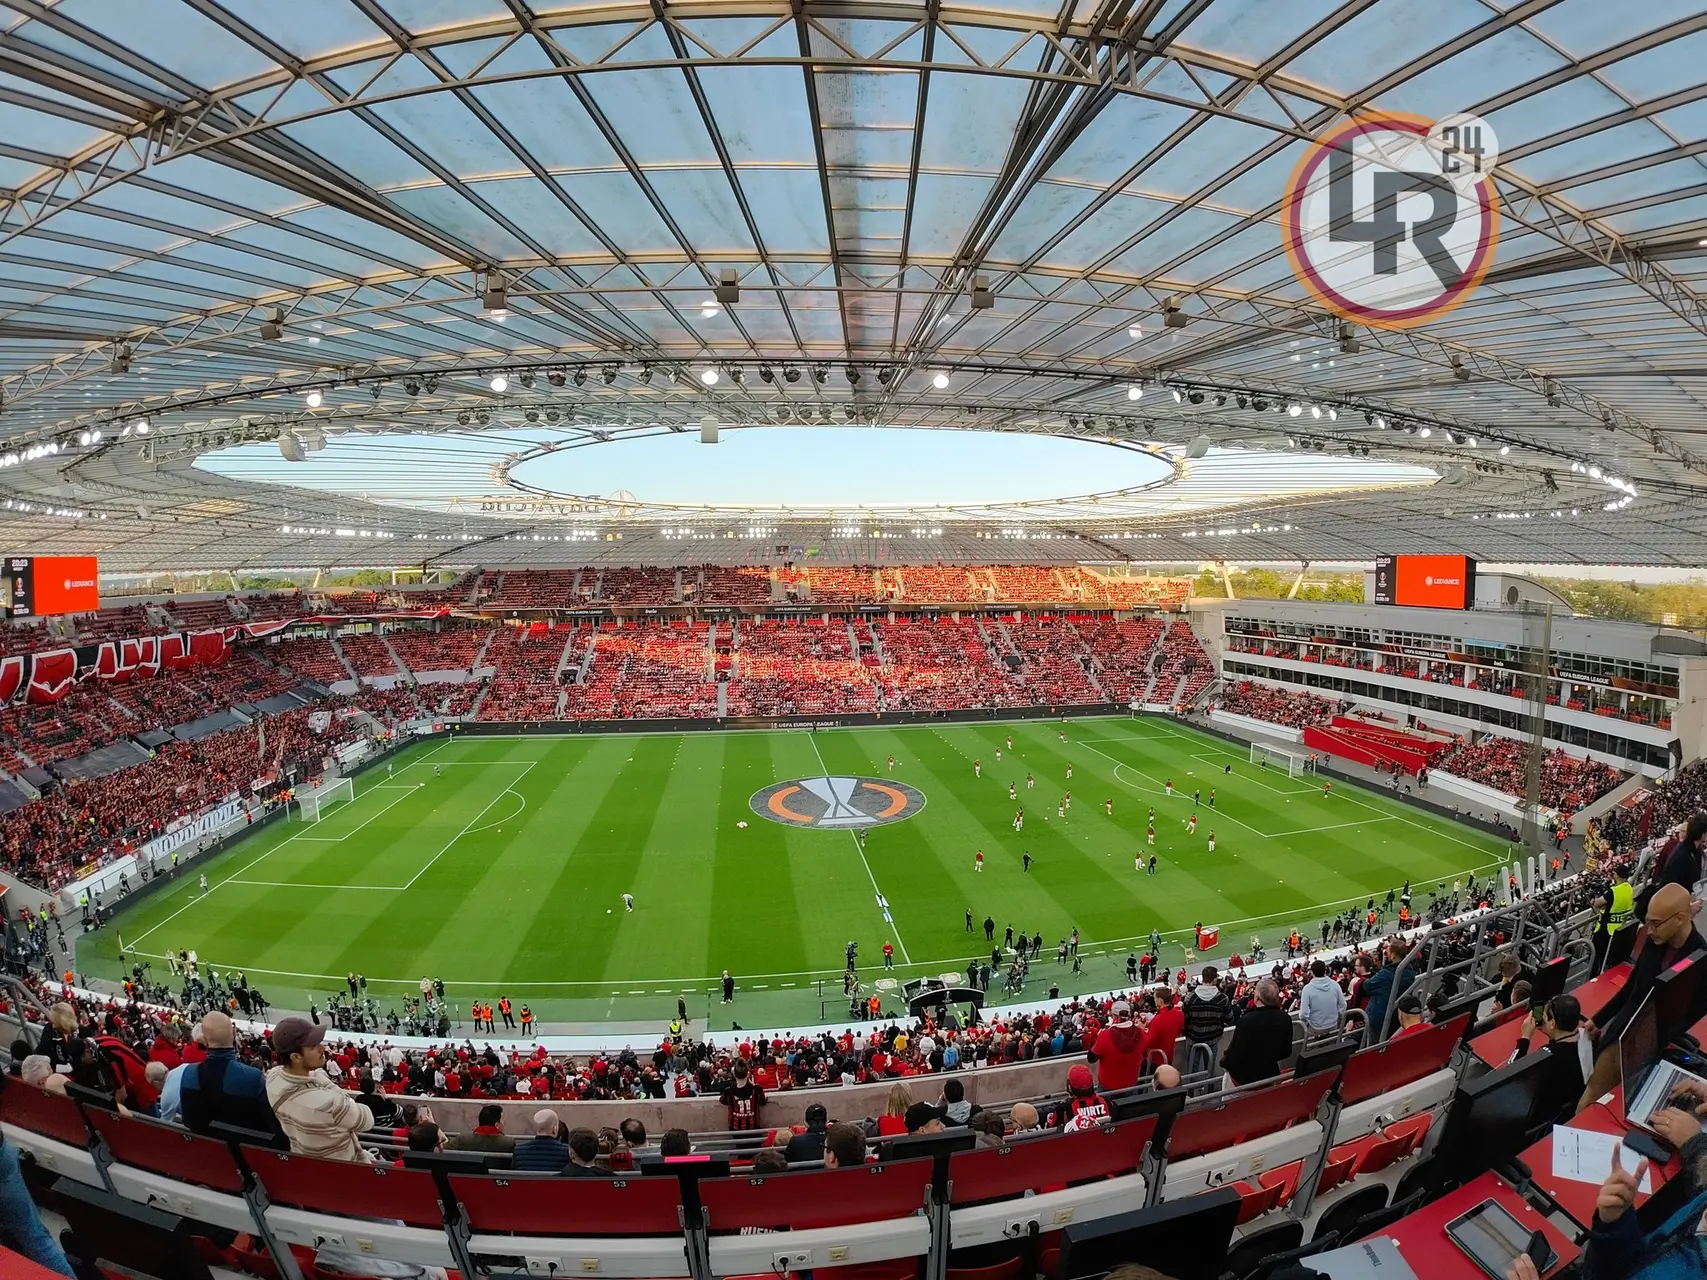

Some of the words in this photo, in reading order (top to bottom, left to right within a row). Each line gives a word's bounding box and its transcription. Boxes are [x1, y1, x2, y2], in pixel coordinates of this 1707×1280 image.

[1433, 578, 1460, 586] LEDVANCE
[1572, 673, 1590, 681] EUROPA
[1590, 676, 1609, 684] LEAGUE
[1077, 1104, 1107, 1116] WIRTZ
[998, 1147, 1011, 1155] 50
[870, 1166, 882, 1174] 51
[496, 1179, 509, 1187] 54
[613, 1180, 627, 1188] 53
[750, 1178, 764, 1186] 52
